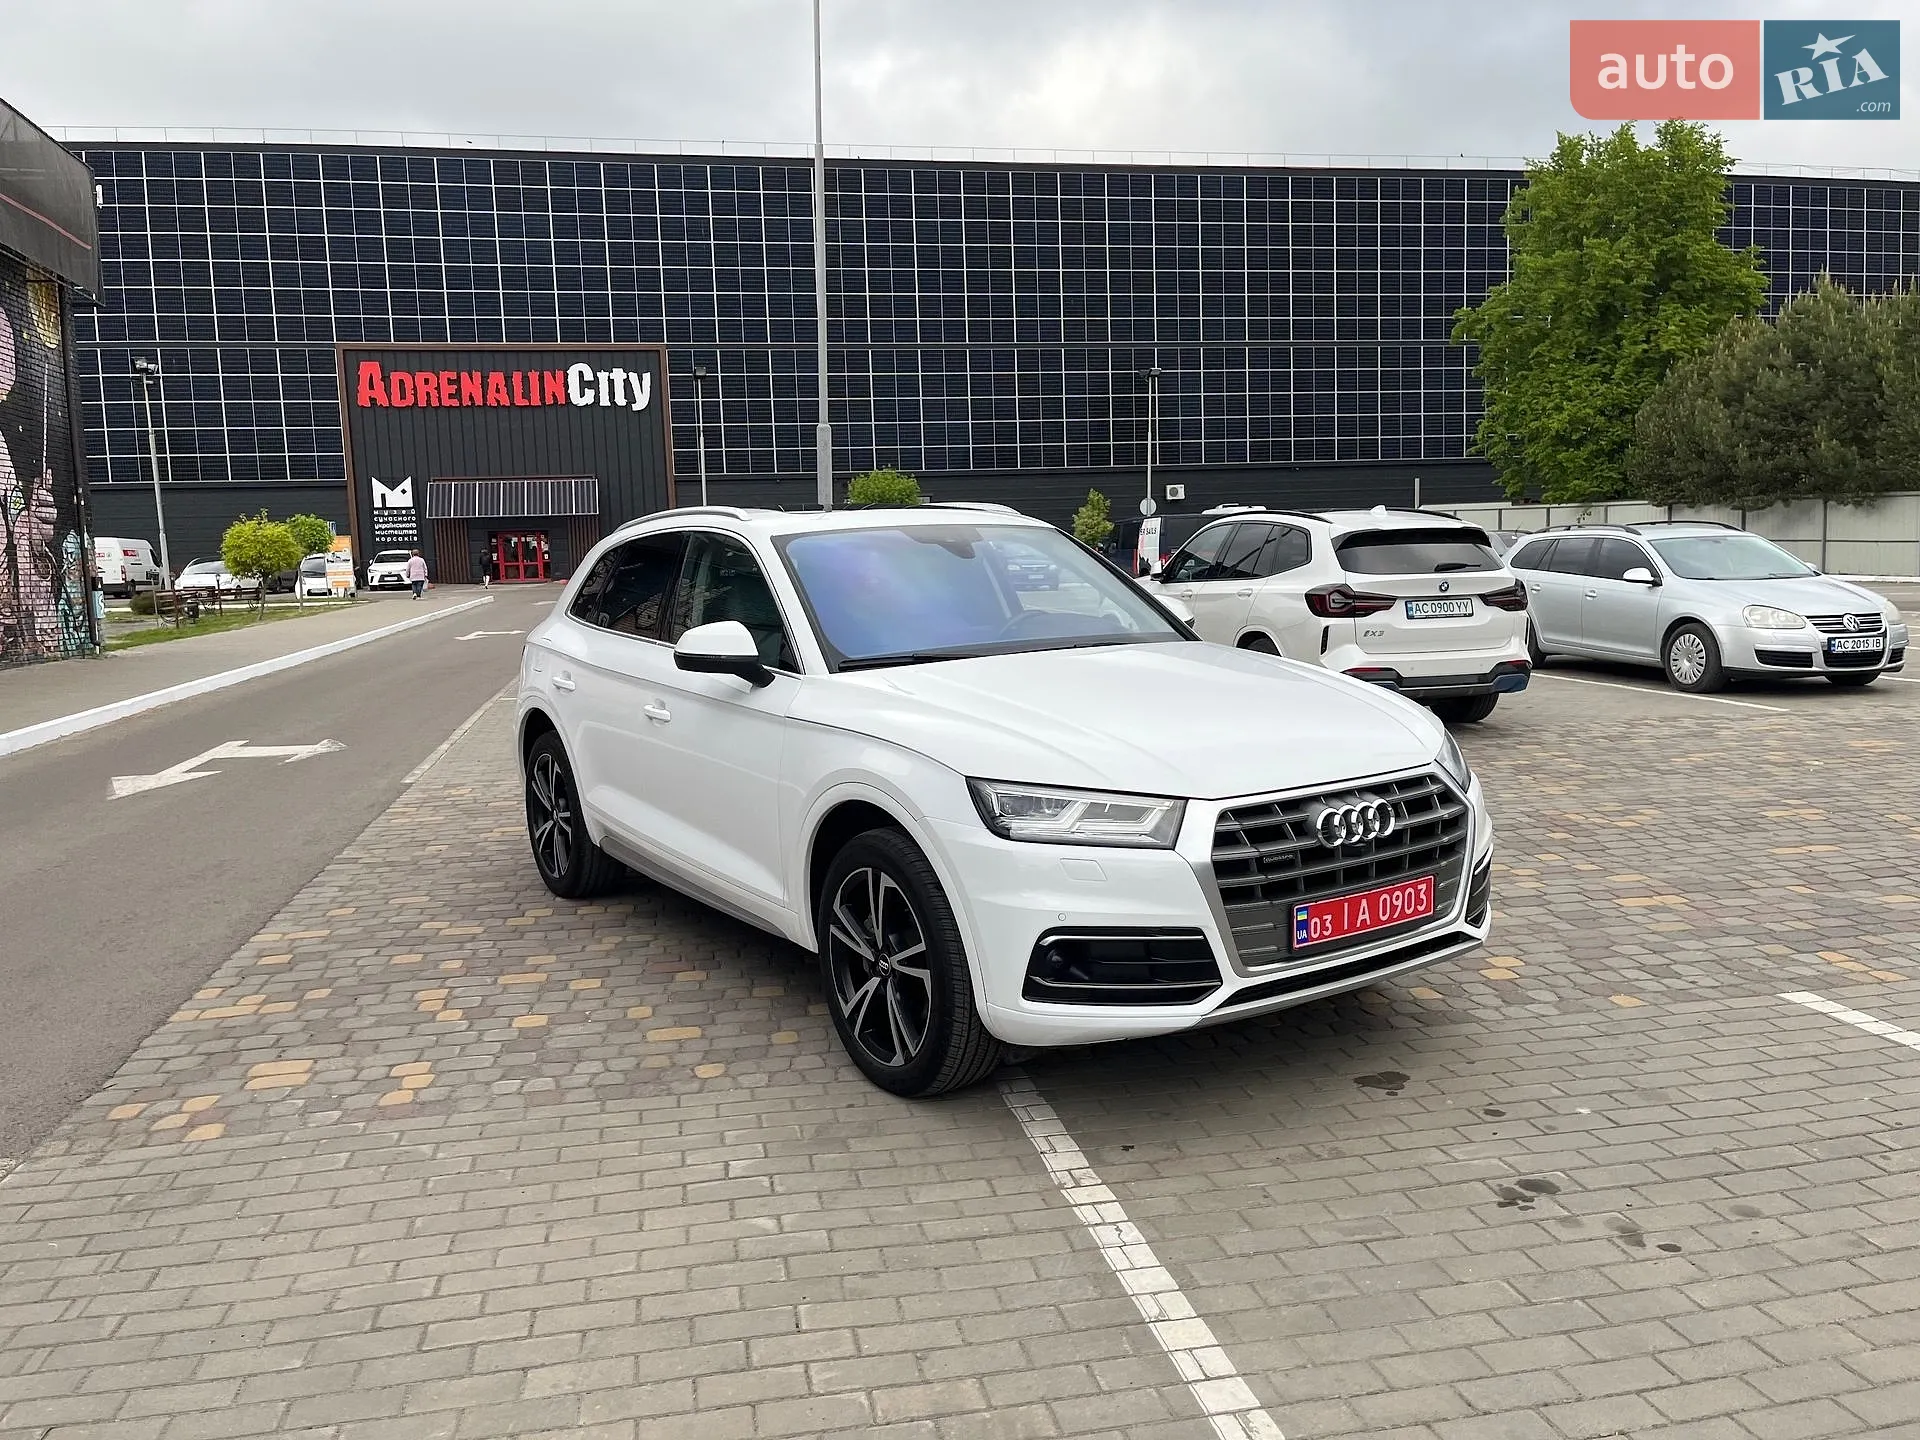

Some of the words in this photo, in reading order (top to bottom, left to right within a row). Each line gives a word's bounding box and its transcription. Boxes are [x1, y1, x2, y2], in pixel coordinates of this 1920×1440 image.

[1414, 602, 1430, 615] AC
[1430, 601, 1455, 614] 0900
[1455, 600, 1469, 613] YY
[1836, 640, 1850, 650] AC
[1850, 639, 1870, 650] 2015
[1872, 638, 1881, 648] IB
[1310, 914, 1332, 939] 03
[1379, 883, 1427, 921] 0903
[1297, 930, 1308, 940] UA
